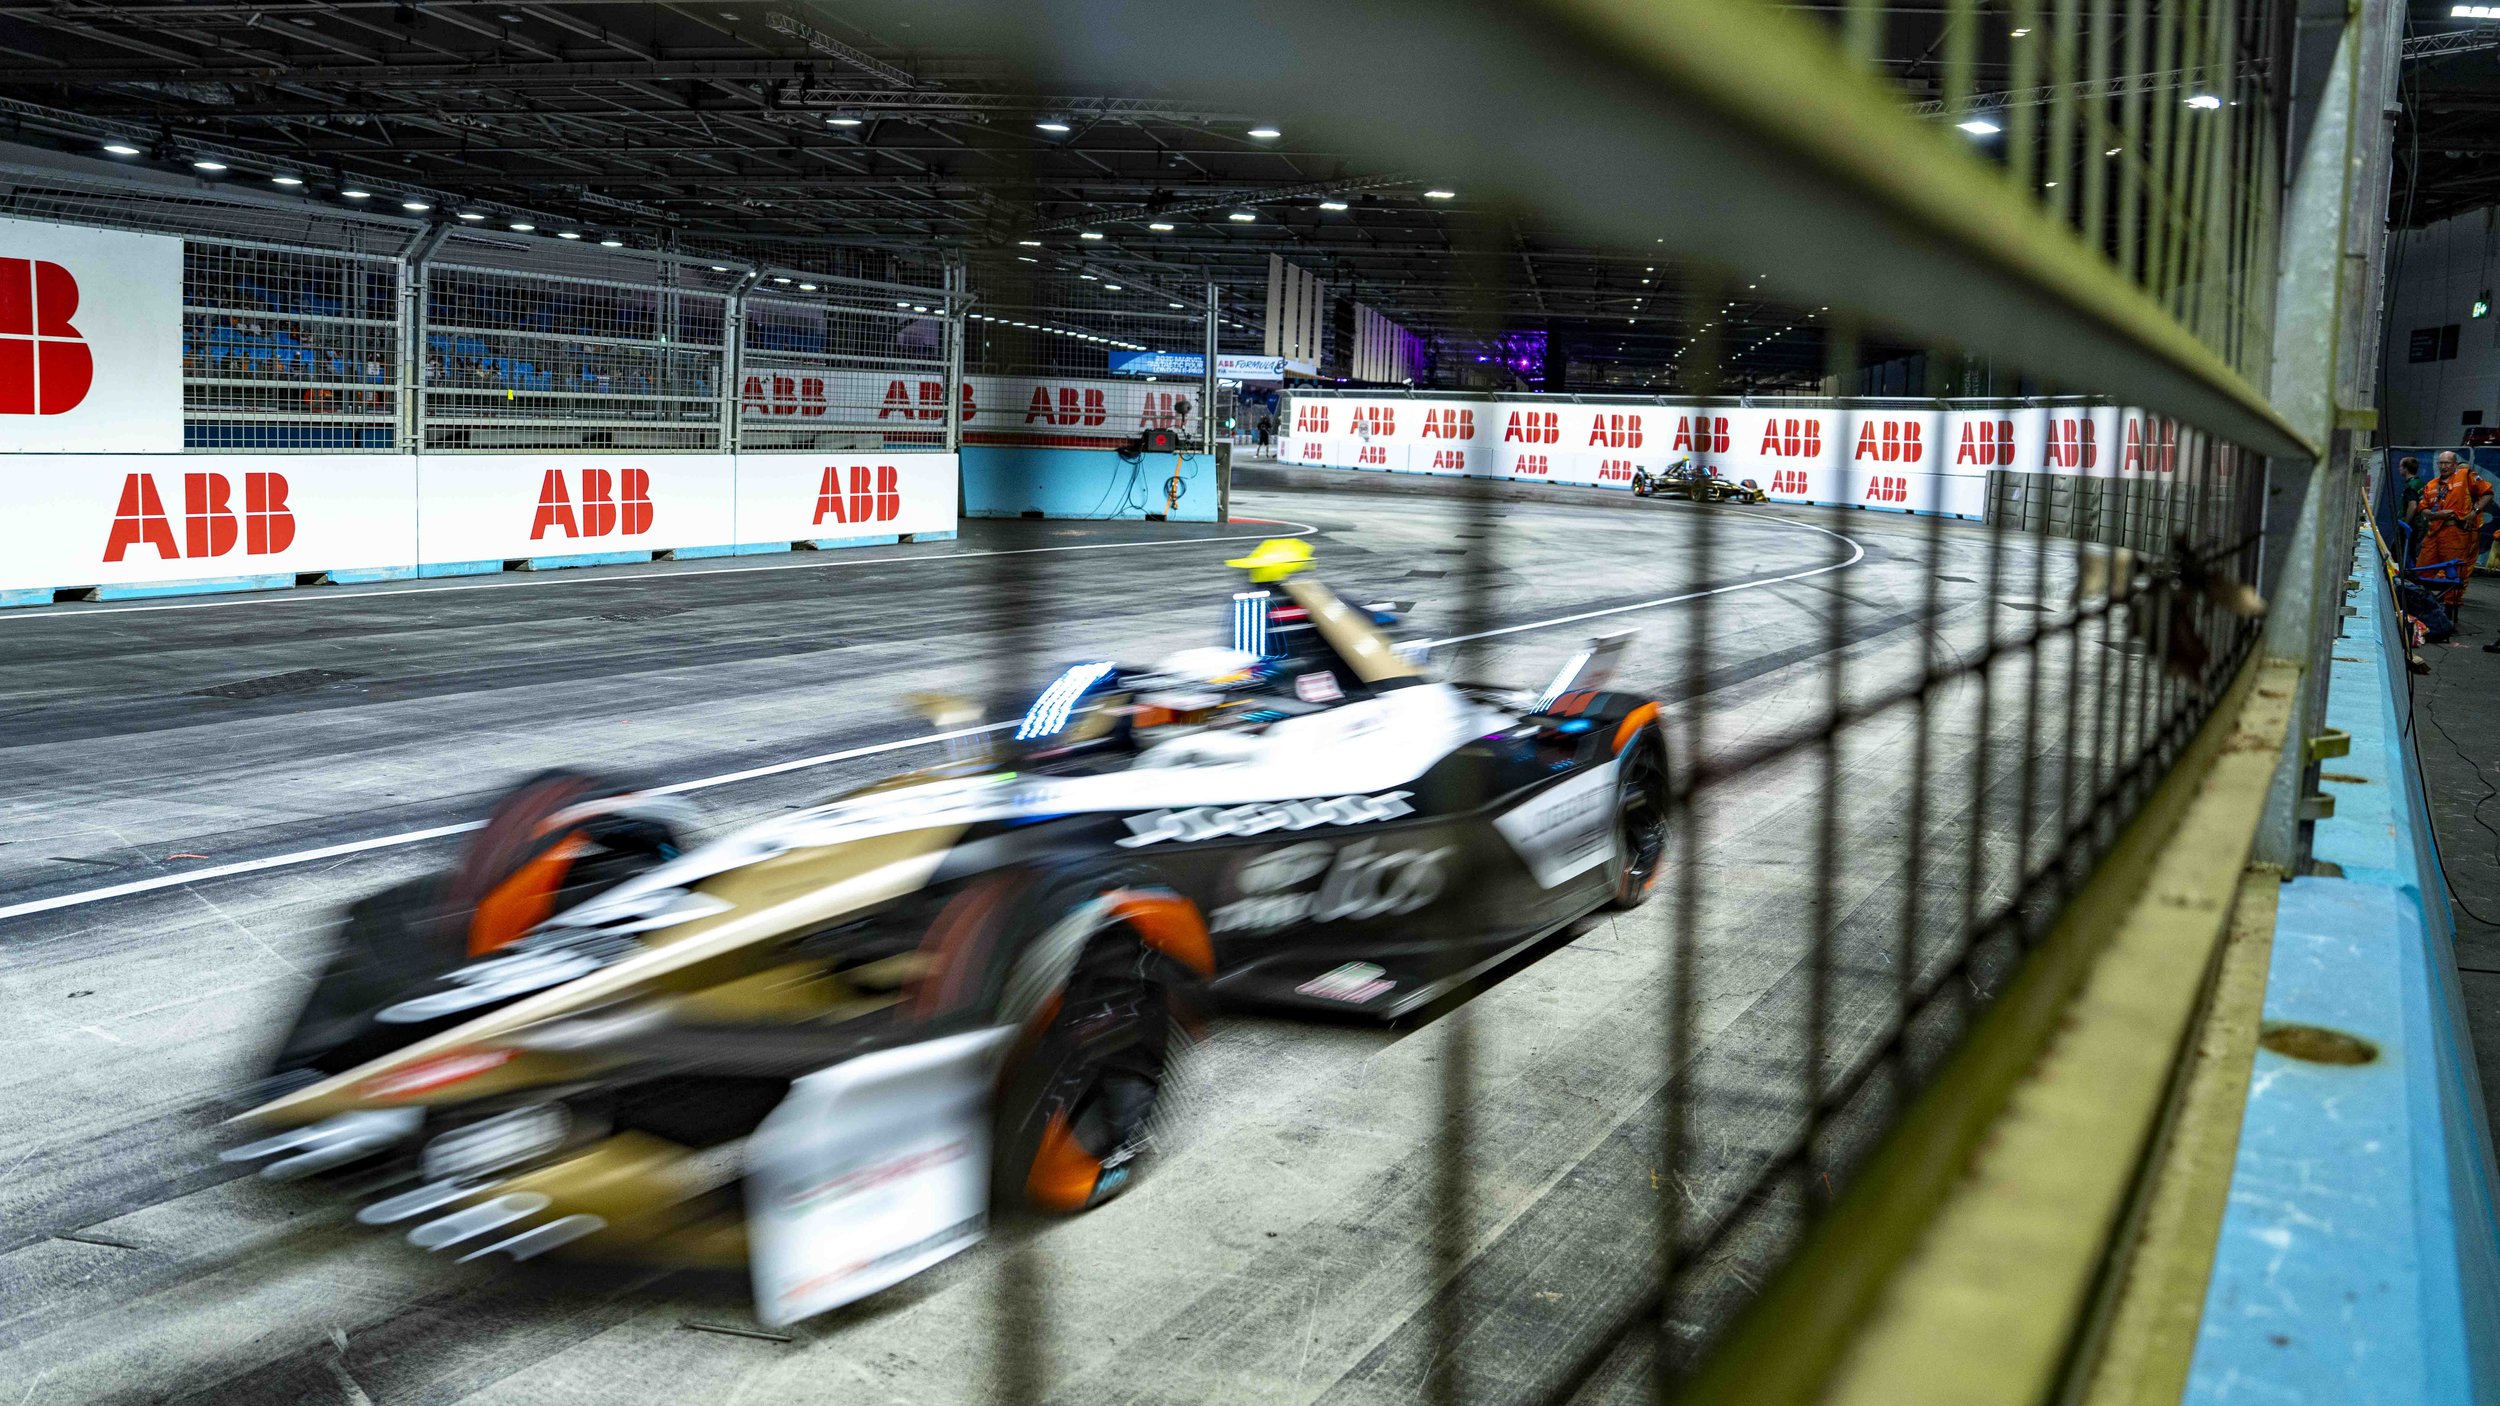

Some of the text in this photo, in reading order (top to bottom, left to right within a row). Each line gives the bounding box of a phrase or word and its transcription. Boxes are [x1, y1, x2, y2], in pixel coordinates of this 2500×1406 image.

[1235, 360, 1273, 370] FORMULA
[742, 376, 827, 416] ABB
[1025, 386, 1106, 426] ABB
[1298, 405, 1329, 433] ABB
[1350, 406, 1395, 436] ABB
[1422, 408, 1475, 440] ABB
[1505, 411, 1559, 445] ABB
[1589, 414, 1644, 449] ABB
[1673, 416, 1730, 453] ABB
[1303, 442, 1322, 460] ABB
[1359, 445, 1386, 465] ABB
[1761, 419, 1822, 458] ABB
[1855, 421, 1922, 463] ABB
[1957, 420, 2015, 465] ABB
[2044, 419, 2097, 468] ABB
[2124, 418, 2176, 473] ABB
[1433, 450, 1465, 469] ABB
[1515, 454, 1548, 475] ABB
[1598, 459, 1631, 481] ABB
[812, 465, 901, 526] ABB
[1770, 470, 1808, 494] ABB
[1866, 476, 1907, 503] ABB
[103, 471, 296, 563] ABB
[530, 468, 654, 541] ABB
